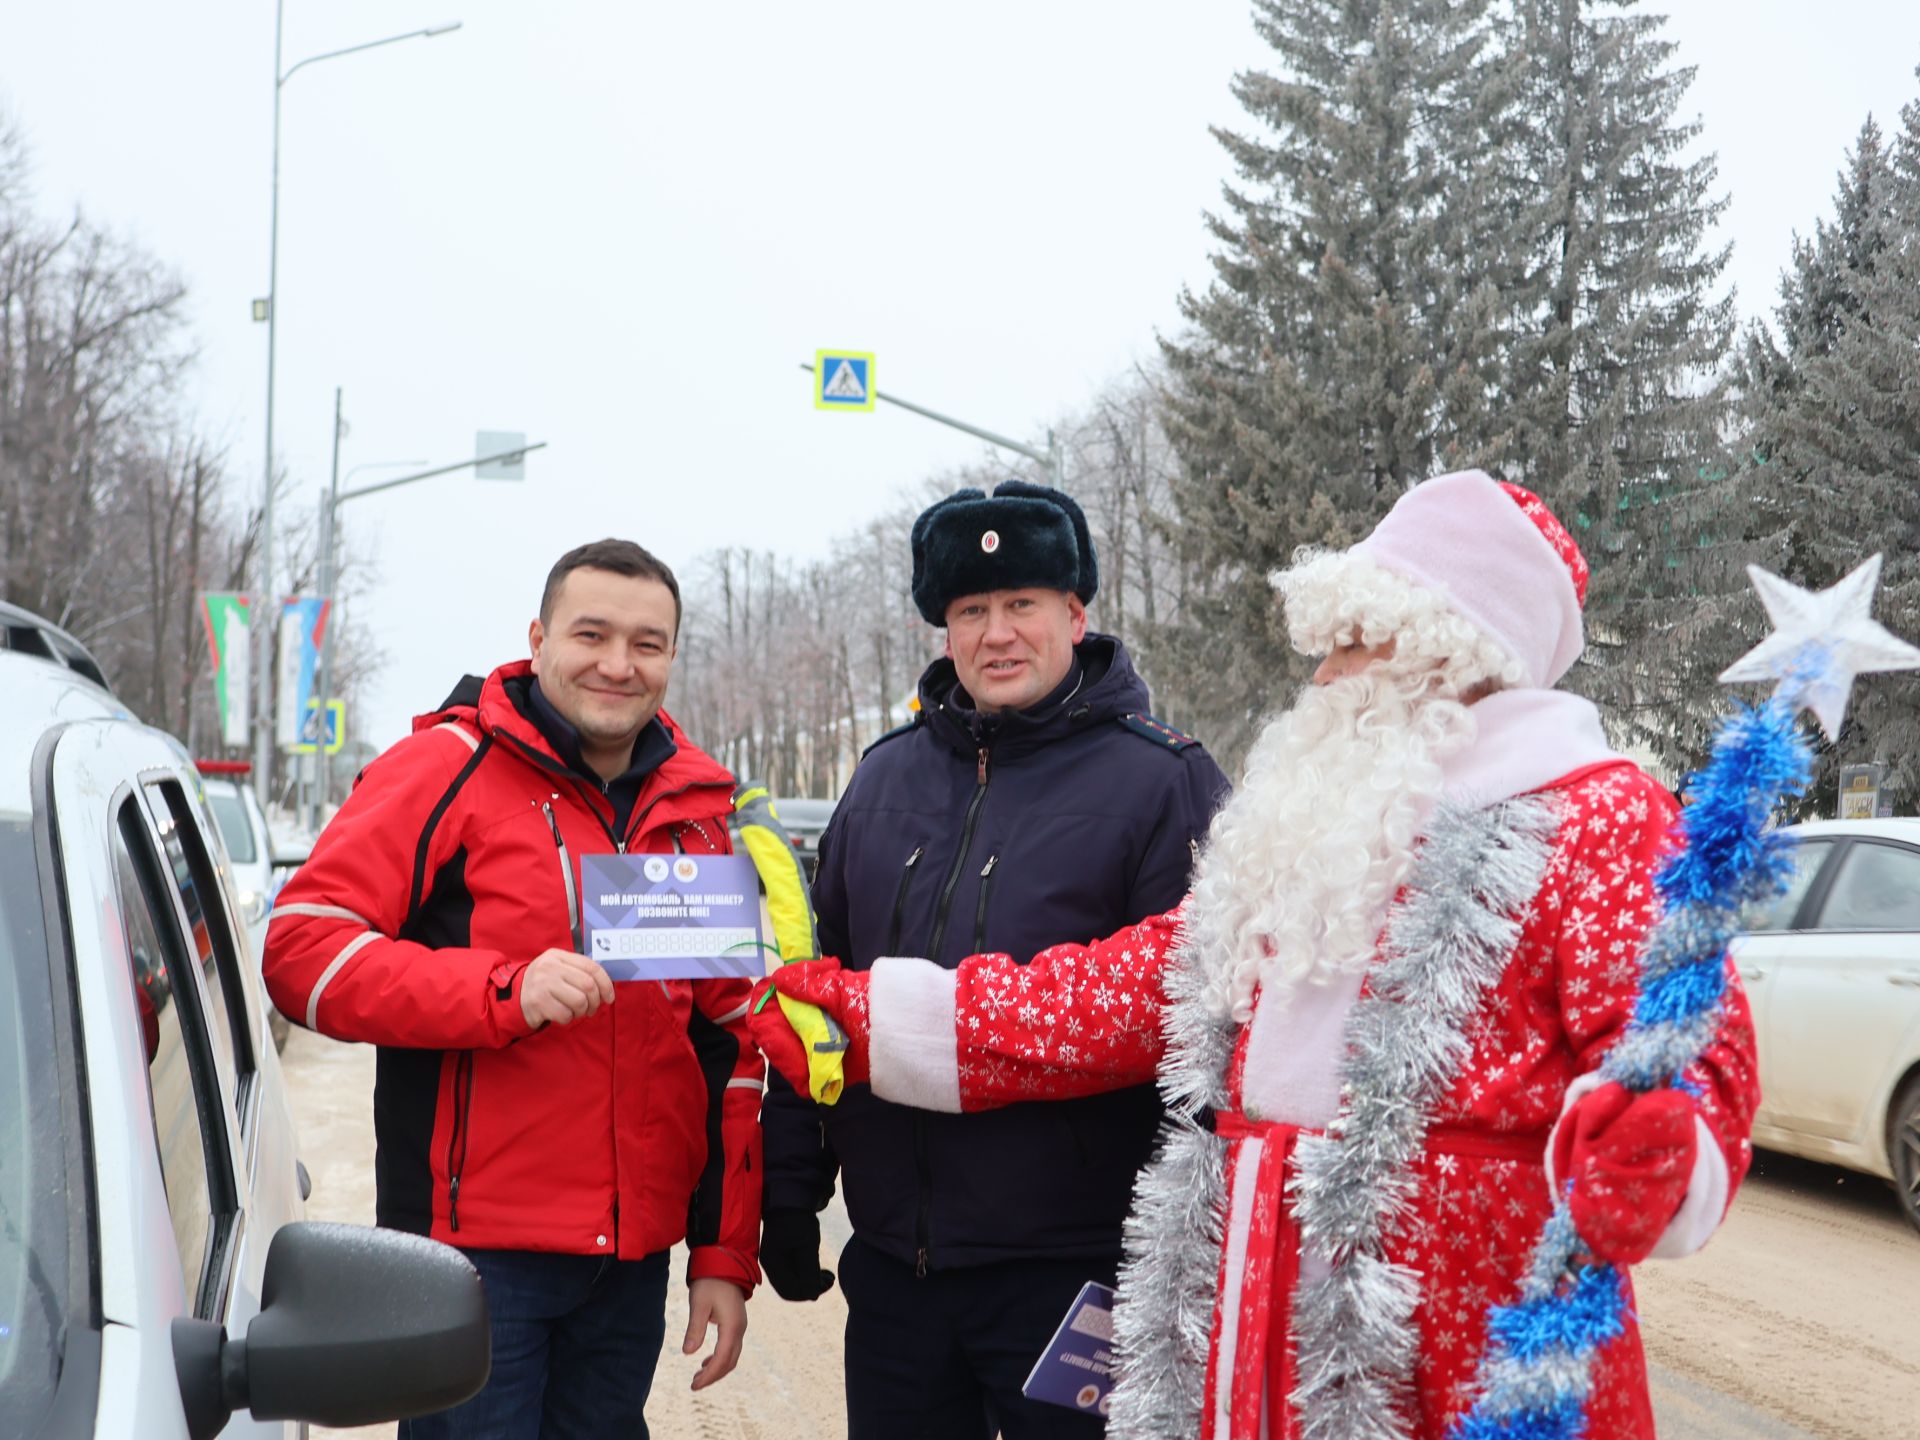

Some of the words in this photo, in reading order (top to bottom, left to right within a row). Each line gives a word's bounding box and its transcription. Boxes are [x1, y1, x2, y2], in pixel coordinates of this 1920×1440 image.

[600, 893, 620, 906] МОЙ
[622, 894, 680, 906] АВТОМОБИЛЬ
[638, 907, 688, 918] ПОЗВОНИТЕ
[689, 907, 710, 918] МНЕ!
